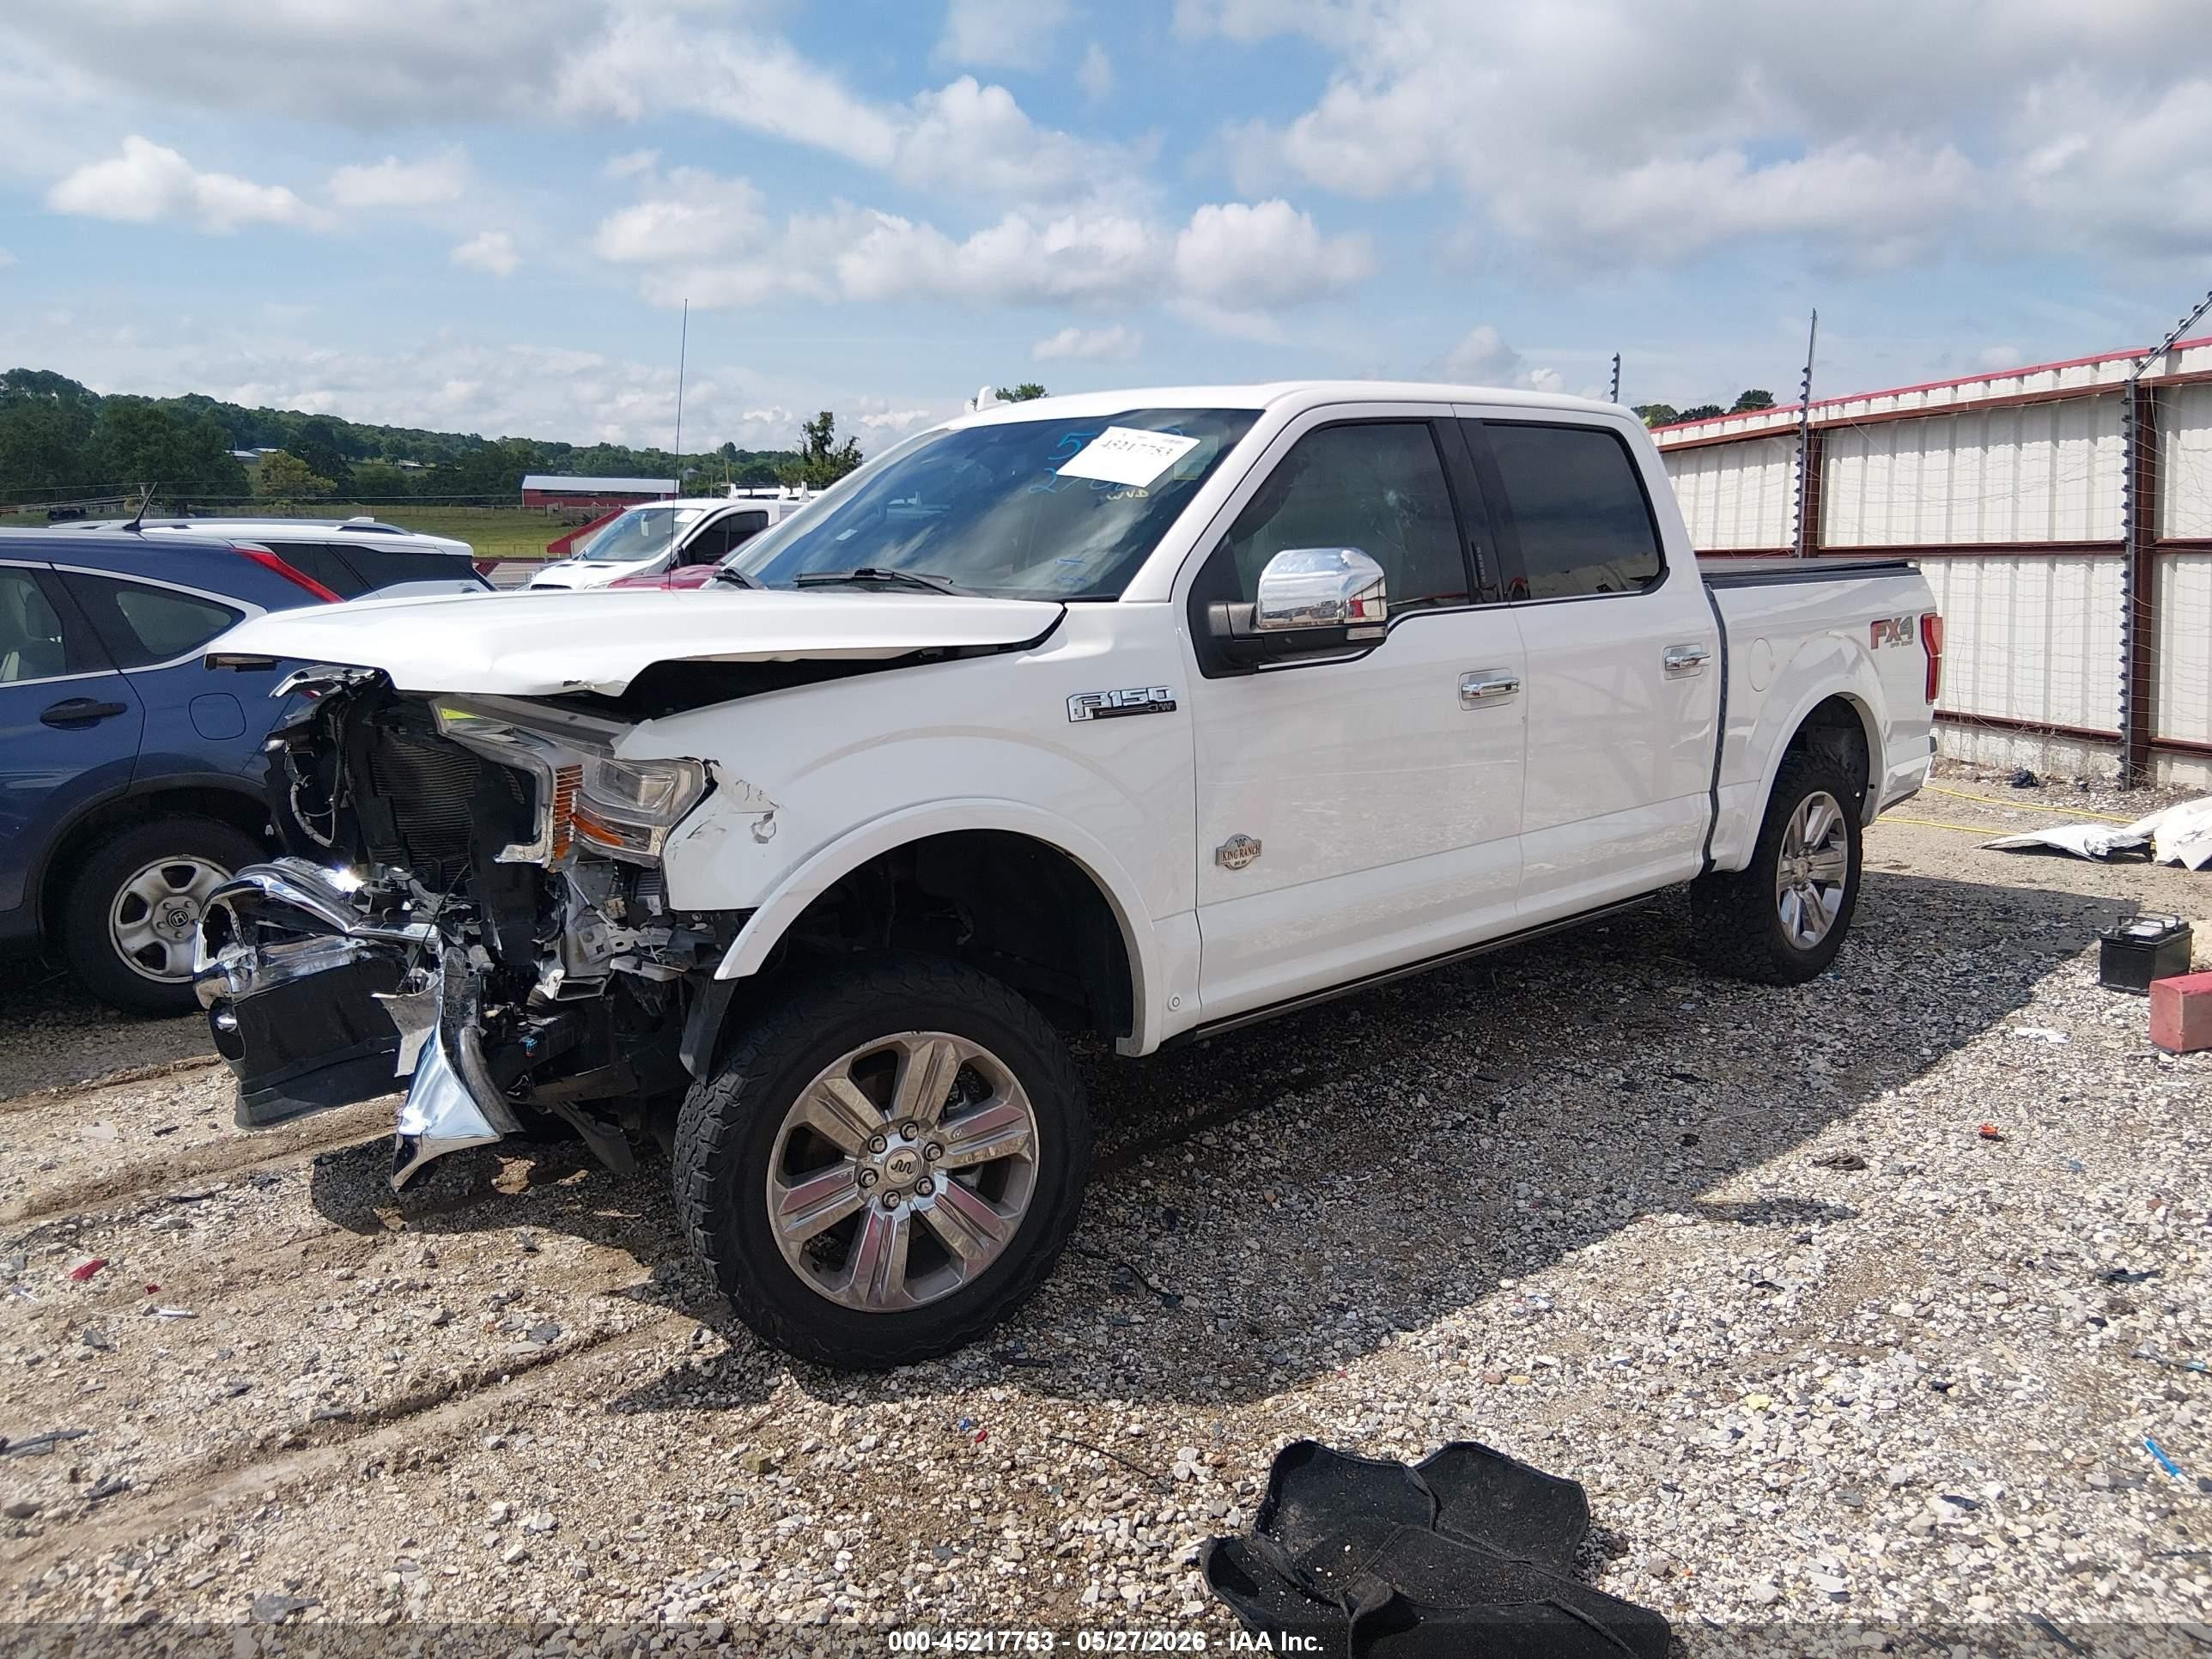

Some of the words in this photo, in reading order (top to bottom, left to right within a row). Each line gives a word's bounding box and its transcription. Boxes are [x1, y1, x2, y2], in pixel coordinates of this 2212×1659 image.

[1870, 616, 1914, 650] FX4
[1223, 849, 1238, 861] KING
[1239, 843, 1261, 858] RANCH
